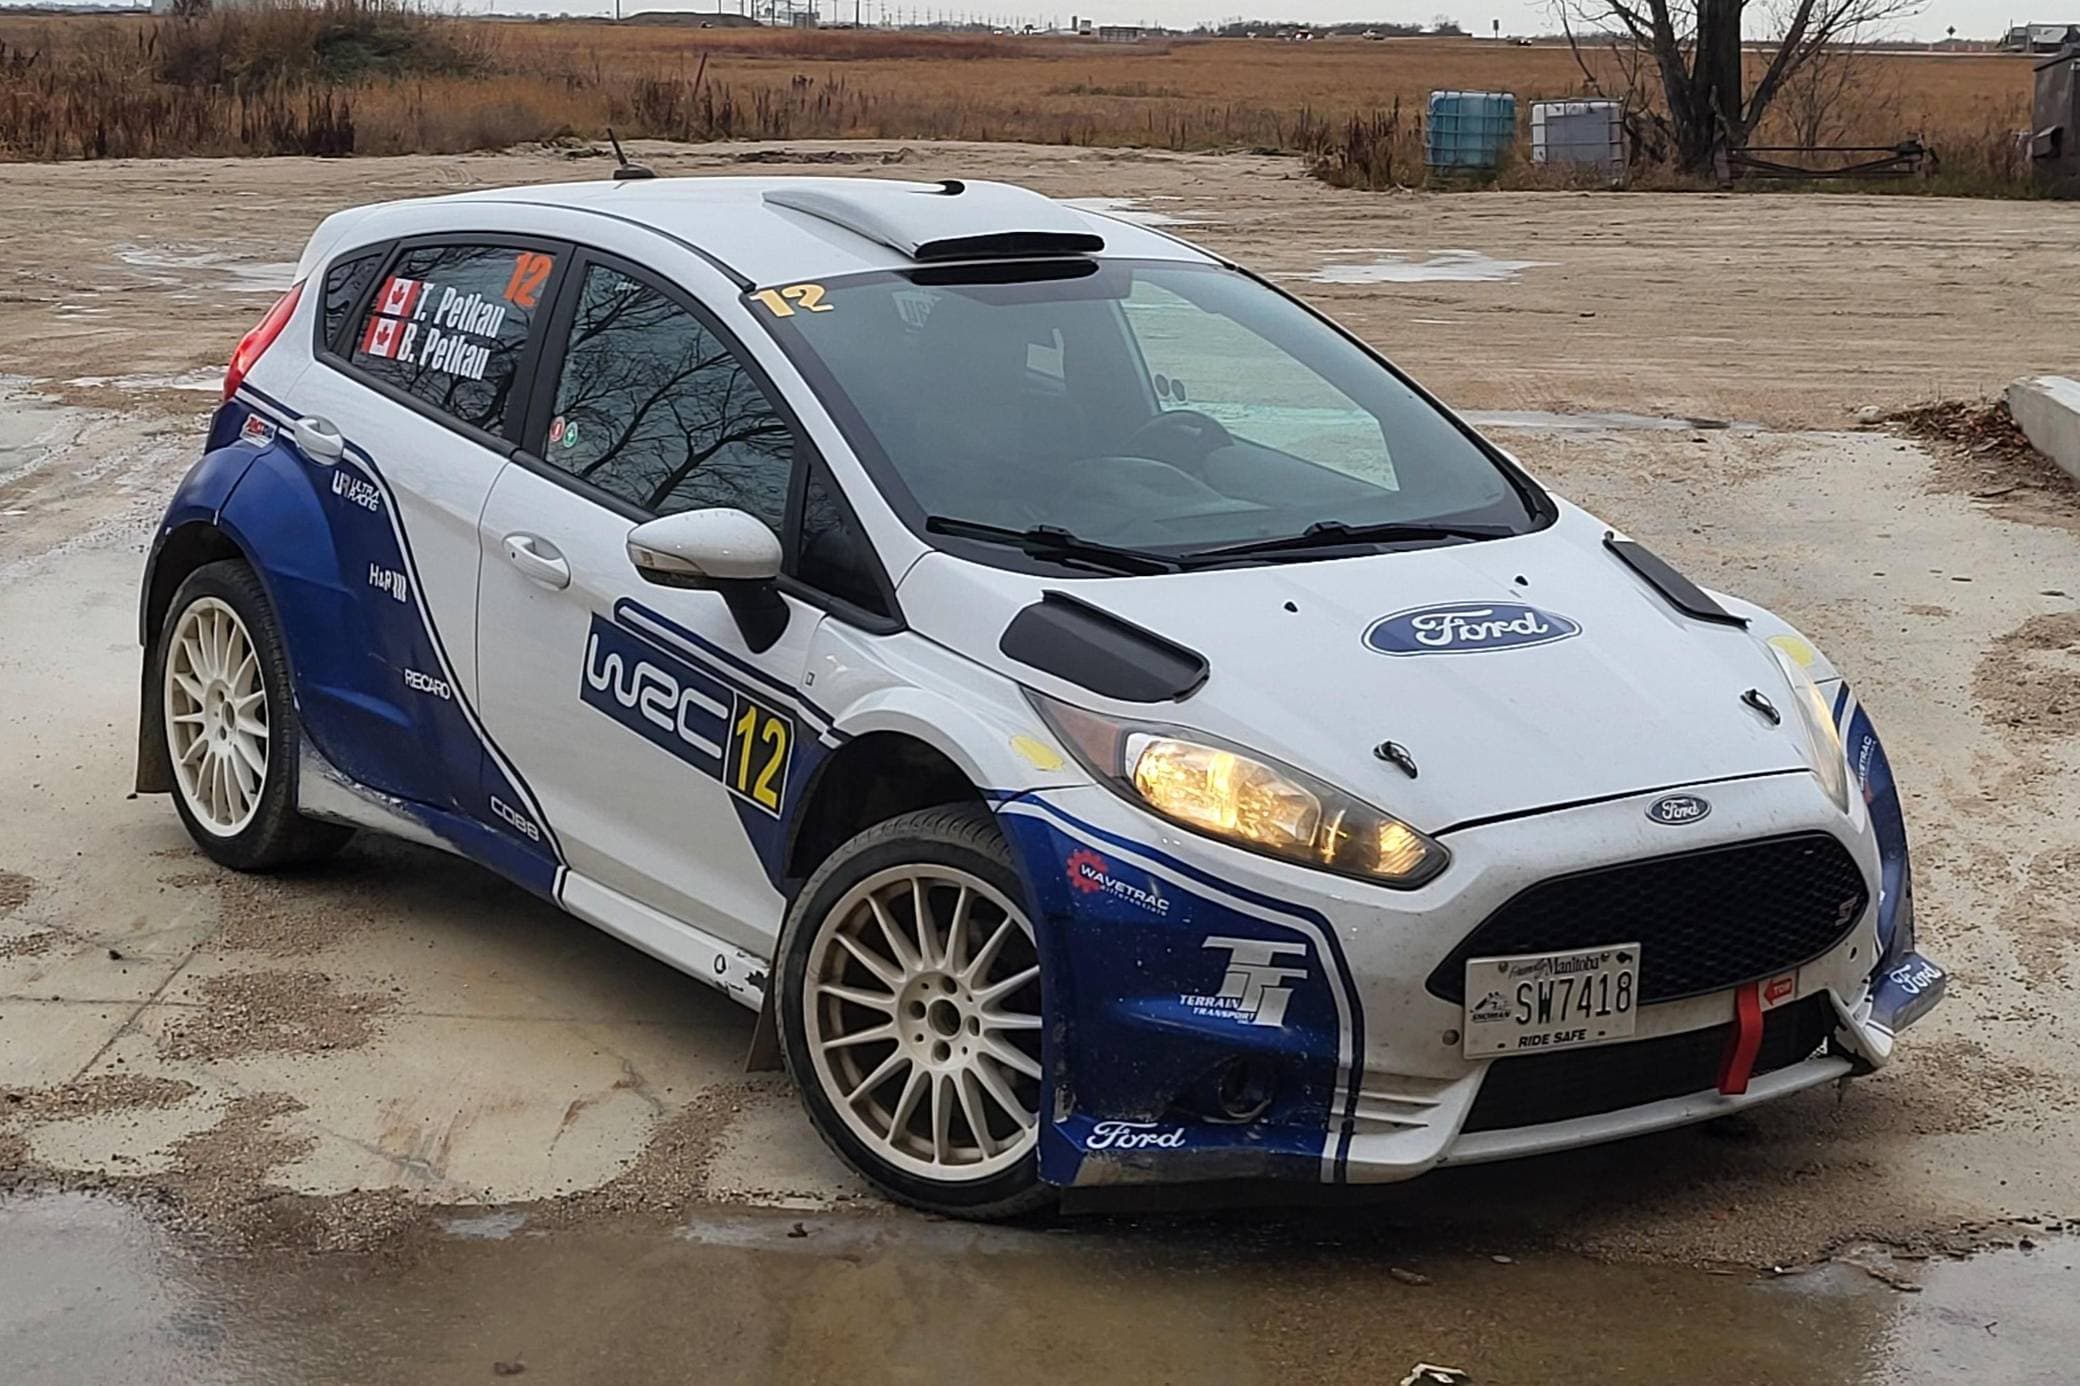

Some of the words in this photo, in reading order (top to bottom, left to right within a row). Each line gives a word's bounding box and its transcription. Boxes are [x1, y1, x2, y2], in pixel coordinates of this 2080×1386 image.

[504, 251, 554, 308] 12
[413, 282, 436, 321] T.
[434, 287, 505, 338] Petkau
[749, 283, 835, 318] 12
[396, 323, 418, 363] B.
[419, 328, 490, 381] Petkau
[351, 478, 380, 501] ULTRA
[1411, 608, 1549, 647] Ford
[404, 668, 451, 700] RECARO
[586, 633, 729, 760] WRC
[736, 704, 787, 810] 12
[491, 795, 540, 842] COBB
[1661, 798, 1700, 821] Ford
[1080, 863, 1171, 911] WAVETRAC
[1542, 956, 1600, 976] Manitoba
[1890, 961, 1942, 994] Ford
[1180, 995, 1241, 1009] TERRAIN
[1515, 970, 1633, 1026] SW7418
[1773, 981, 1791, 995] TOW
[1193, 1007, 1255, 1020] TRANSPORT
[1518, 1034, 1551, 1048] RIDE
[1553, 1028, 1588, 1044] SAFE
[1086, 1120, 1186, 1150] Ford
